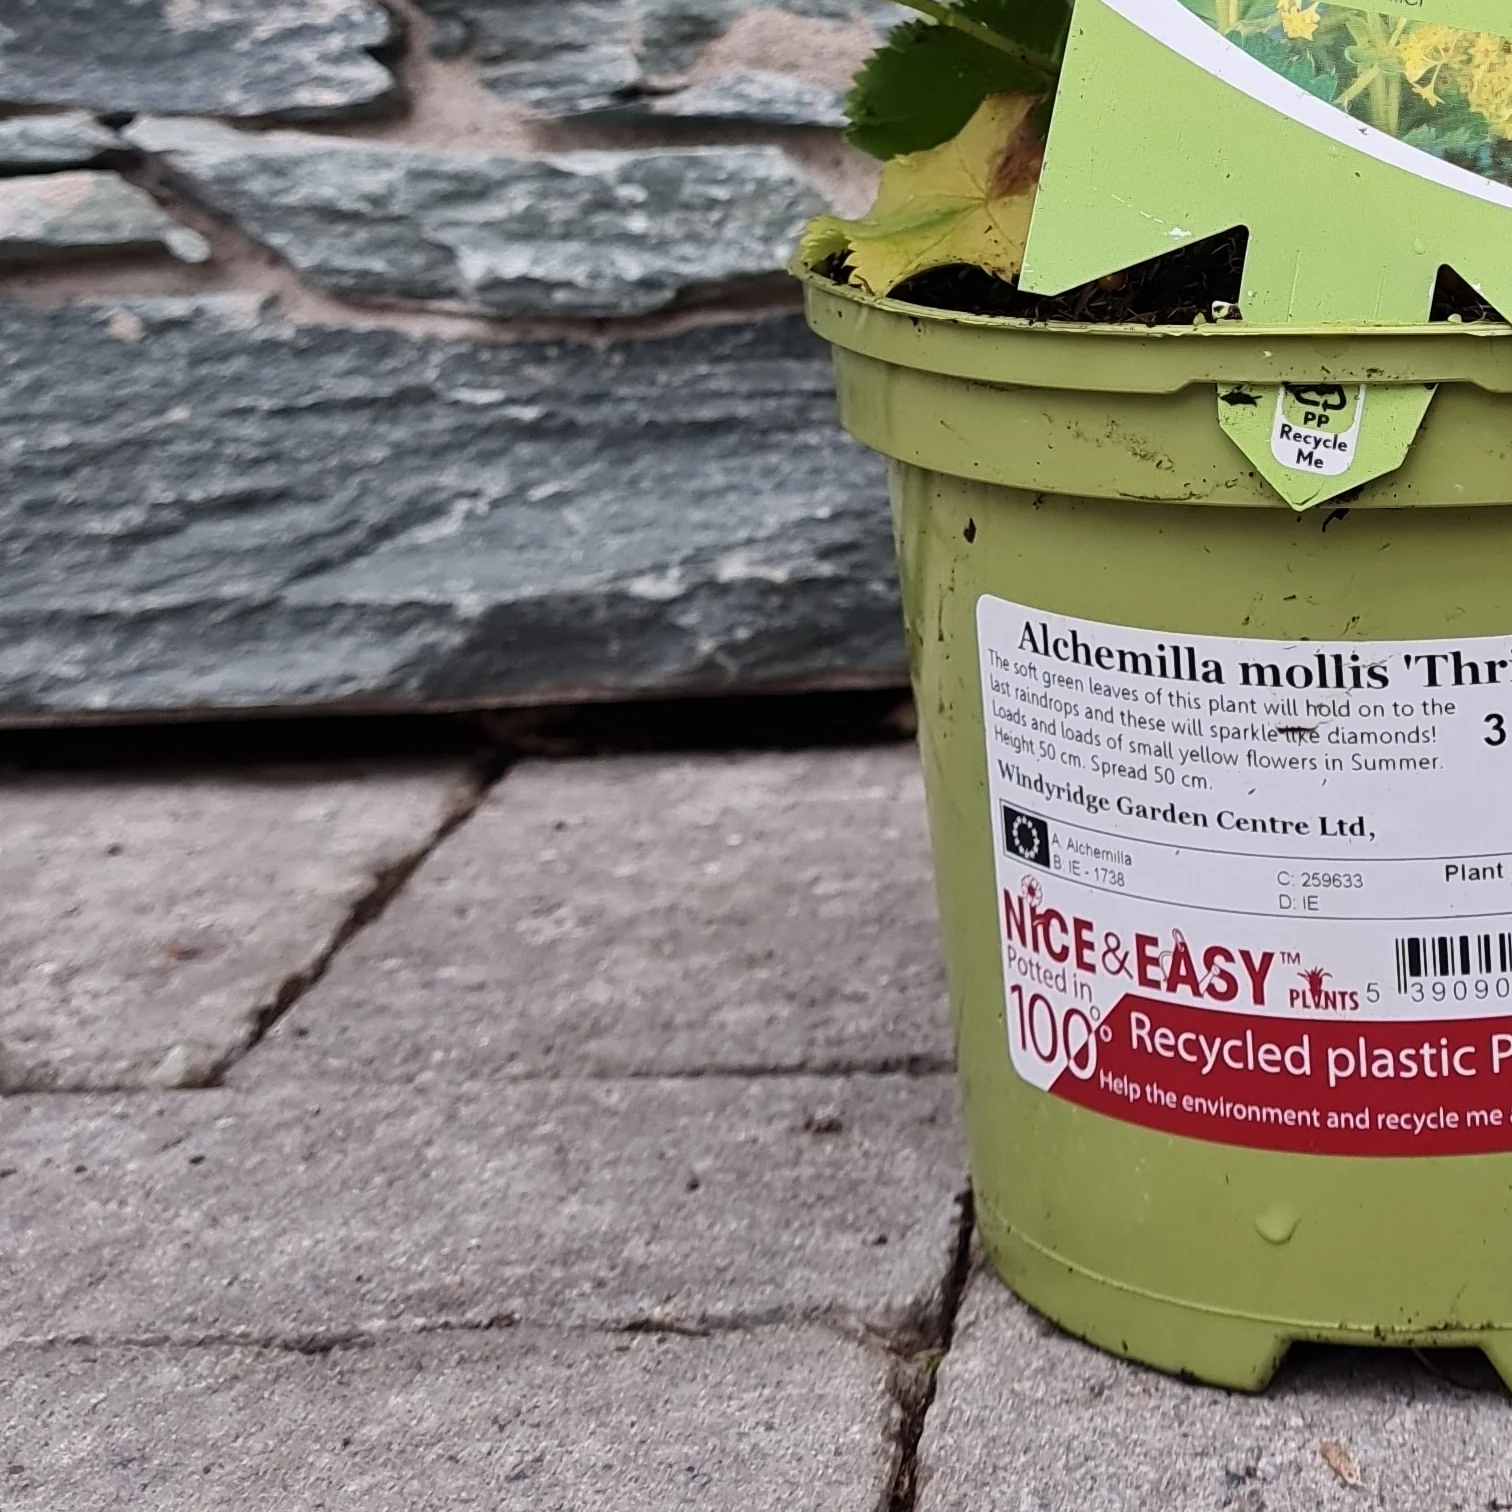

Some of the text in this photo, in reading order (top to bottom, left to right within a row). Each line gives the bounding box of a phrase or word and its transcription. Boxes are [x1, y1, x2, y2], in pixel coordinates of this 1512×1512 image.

[1303, 411, 1330, 428] PP
[1279, 423, 1348, 452] Recycle
[1296, 448, 1324, 469] Me
[1017, 620, 1226, 685] Alchemilla
[1239, 650, 1389, 689] mollis
[988, 648, 1456, 718] The soft green leaves of this plant will hold on to the
[989, 672, 1011, 697] last
[1015, 686, 1080, 719] raindrops
[1084, 706, 1114, 725] and
[1120, 710, 1166, 733] these
[1171, 718, 1204, 737] will
[1210, 722, 1278, 744] sparkle
[1327, 725, 1437, 745] diamonds!
[991, 699, 1444, 772] Loads and loads of small yellow flowers in Summer.
[1483, 713, 1507, 746] 3
[994, 724, 1213, 790] Height 50 cm. Spread 50 cm.
[997, 759, 1111, 814] Windyridge
[1116, 796, 1209, 829] Garden
[1217, 810, 1310, 836] Centre
[1066, 837, 1133, 866] Alchemilla
[1068, 860, 1081, 877] IE
[1094, 867, 1126, 887] 1738
[1276, 870, 1364, 889] C: 259633
[1444, 862, 1505, 883] Plant
[1279, 894, 1320, 911] D: IE
[1007, 944, 1093, 1004] Potted in
[1366, 982, 1380, 1003] 5
[1130, 1010, 1312, 1076] Recycled
[1327, 1036, 1477, 1087] plastic
[1099, 1068, 1142, 1103] Help
[1145, 1082, 1177, 1109] the
[1182, 1094, 1320, 1128] environment
[1327, 1107, 1370, 1130] and
[1377, 1106, 1460, 1135] recycle
[1466, 1107, 1504, 1127] me
